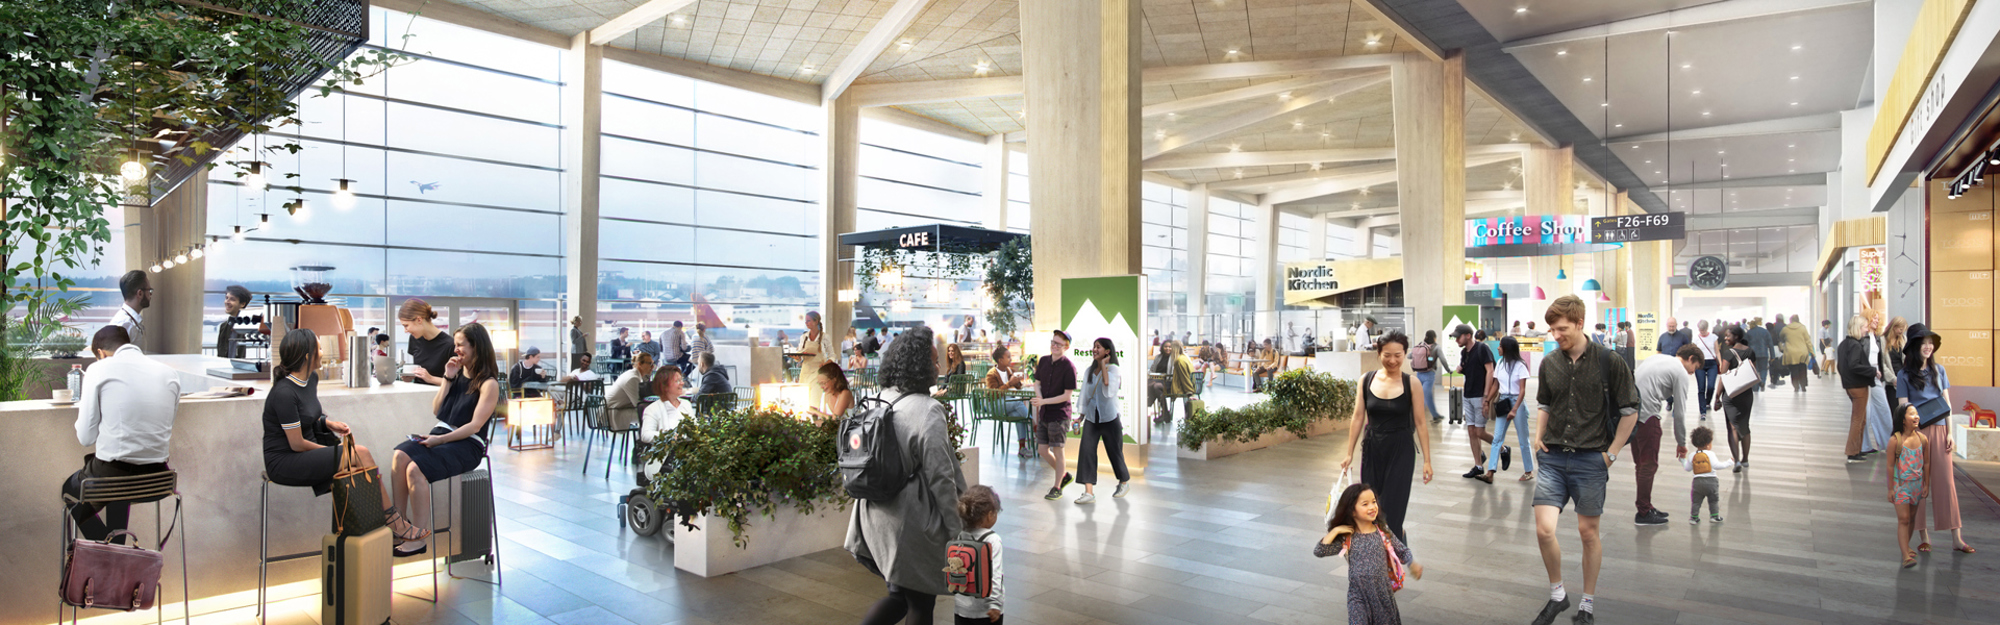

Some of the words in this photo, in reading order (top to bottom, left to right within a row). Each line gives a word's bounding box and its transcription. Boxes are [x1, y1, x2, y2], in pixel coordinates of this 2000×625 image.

[1617, 215, 1669, 227] F26-F69
[1474, 222, 1532, 238] Coffee
[1541, 220, 1585, 241] Shop
[900, 232, 928, 247] CAFE
[1288, 266, 1333, 278] Nordic
[1288, 278, 1338, 290] Kitchen
[1861, 282, 1883, 292] OFF
